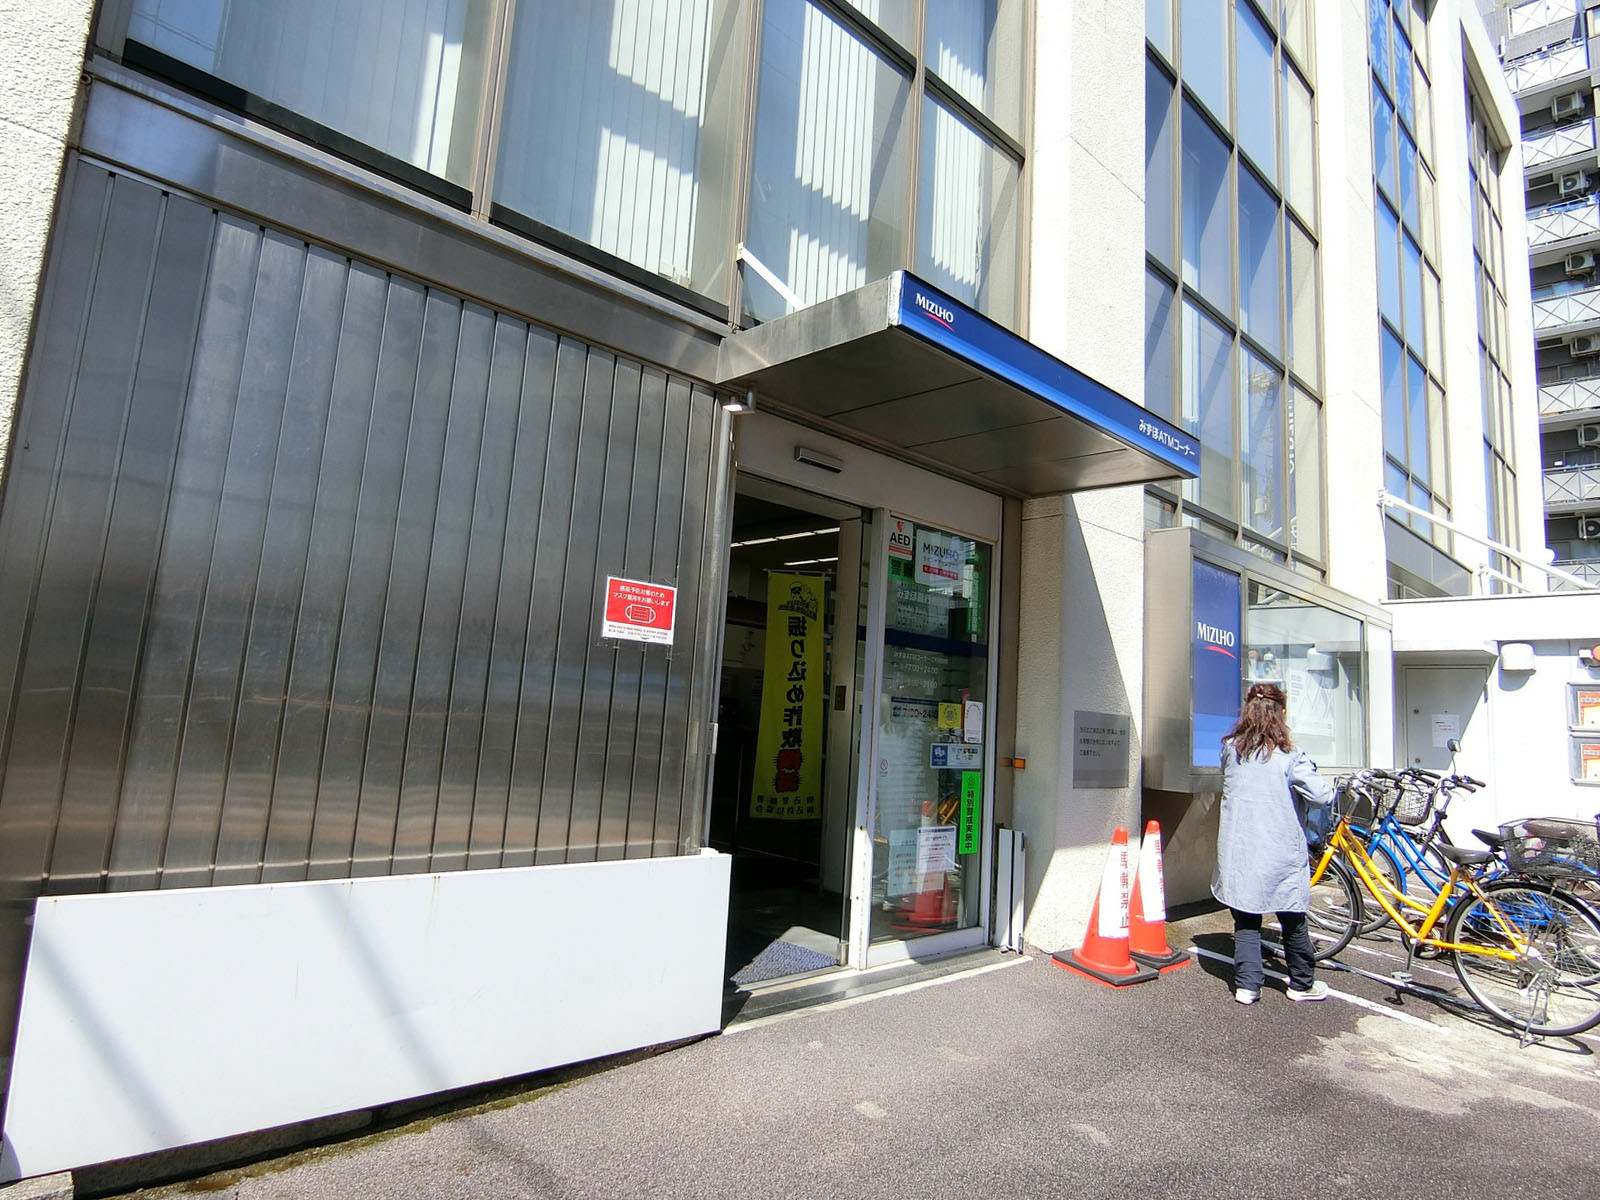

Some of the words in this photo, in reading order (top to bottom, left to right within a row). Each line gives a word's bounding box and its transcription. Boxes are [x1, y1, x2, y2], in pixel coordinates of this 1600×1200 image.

[915, 293, 954, 323] MIZUHO
[1138, 418, 1196, 456] みずほATMコーナー
[889, 531, 911, 546] AED
[922, 543, 960, 562] MIZUHO
[1196, 621, 1235, 647] MIZUHO
[964, 790, 975, 851] 特別警戒実施中
